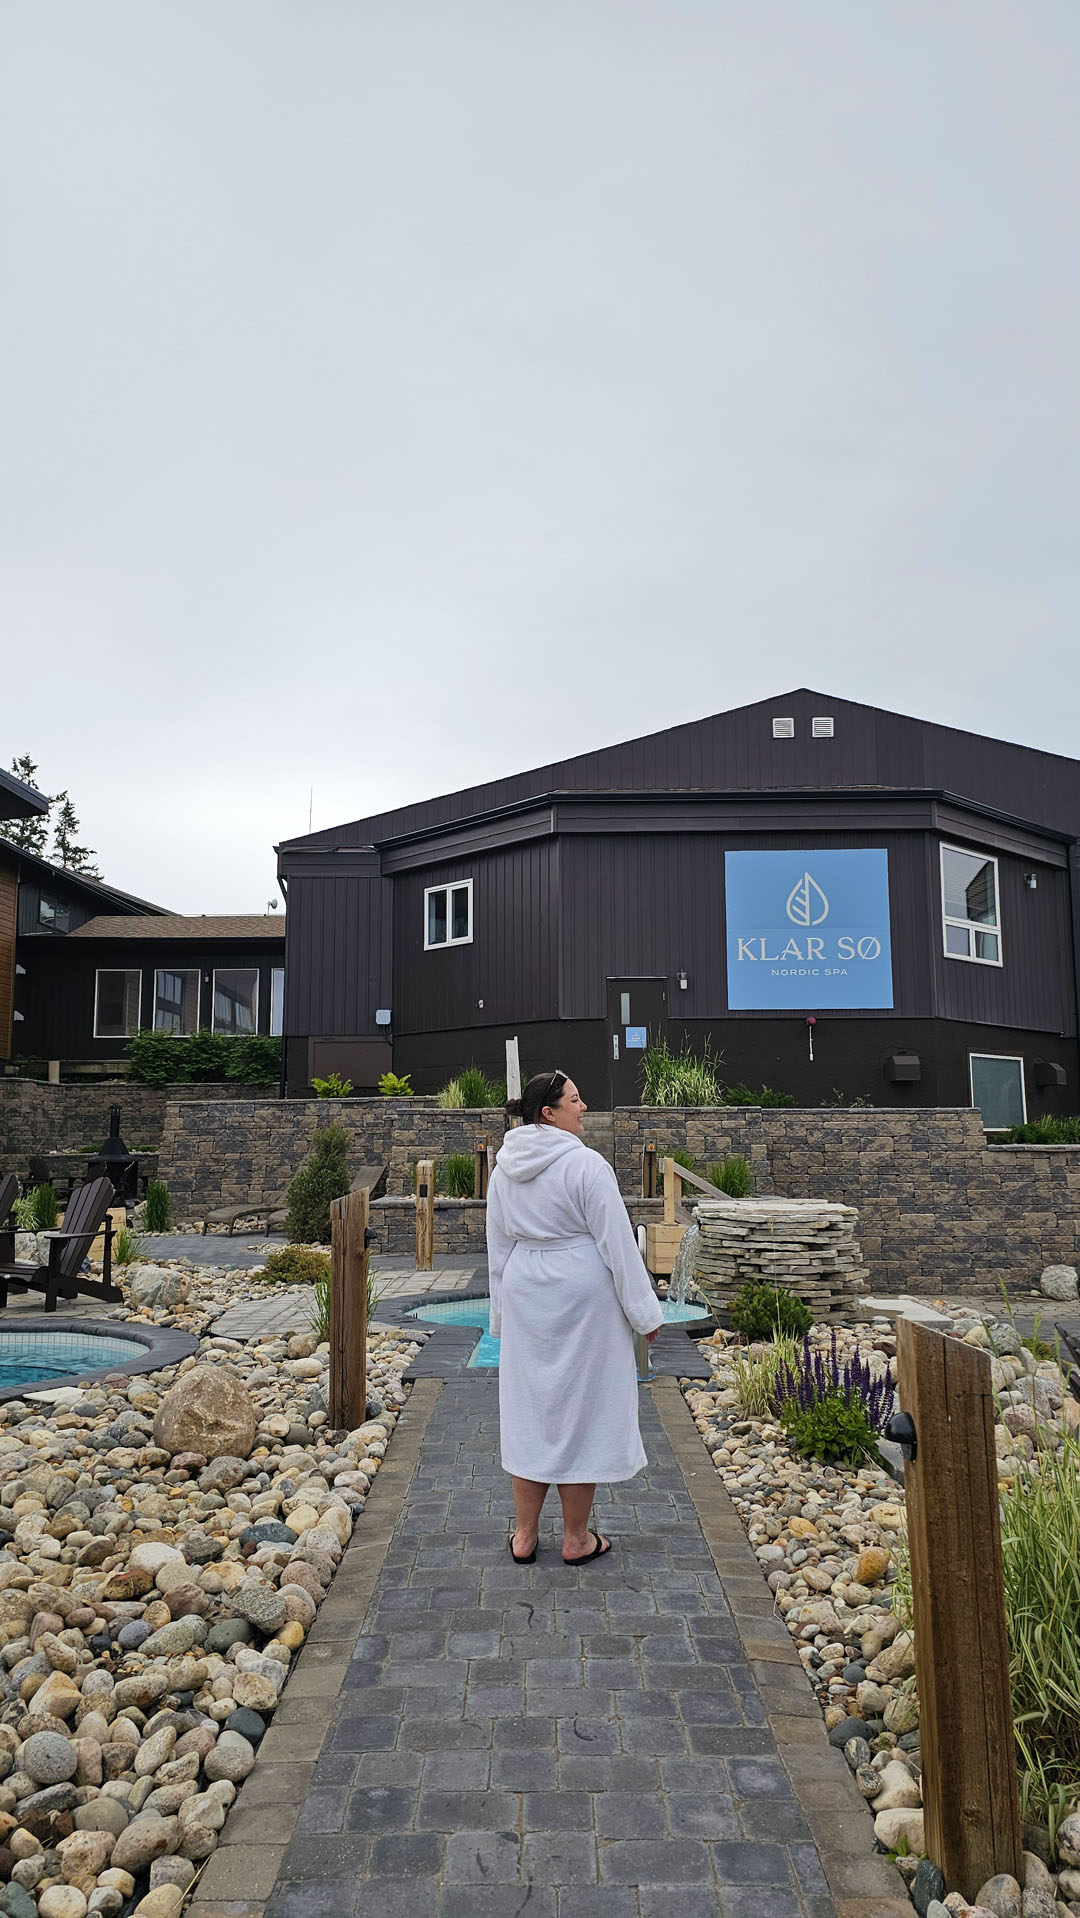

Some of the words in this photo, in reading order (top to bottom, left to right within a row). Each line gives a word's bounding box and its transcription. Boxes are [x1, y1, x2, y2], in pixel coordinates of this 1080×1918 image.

[736, 937, 826, 961] KLAR
[837, 936, 881, 960] SØ
[771, 968, 820, 976] NORDIC
[824, 968, 848, 976] SPA
